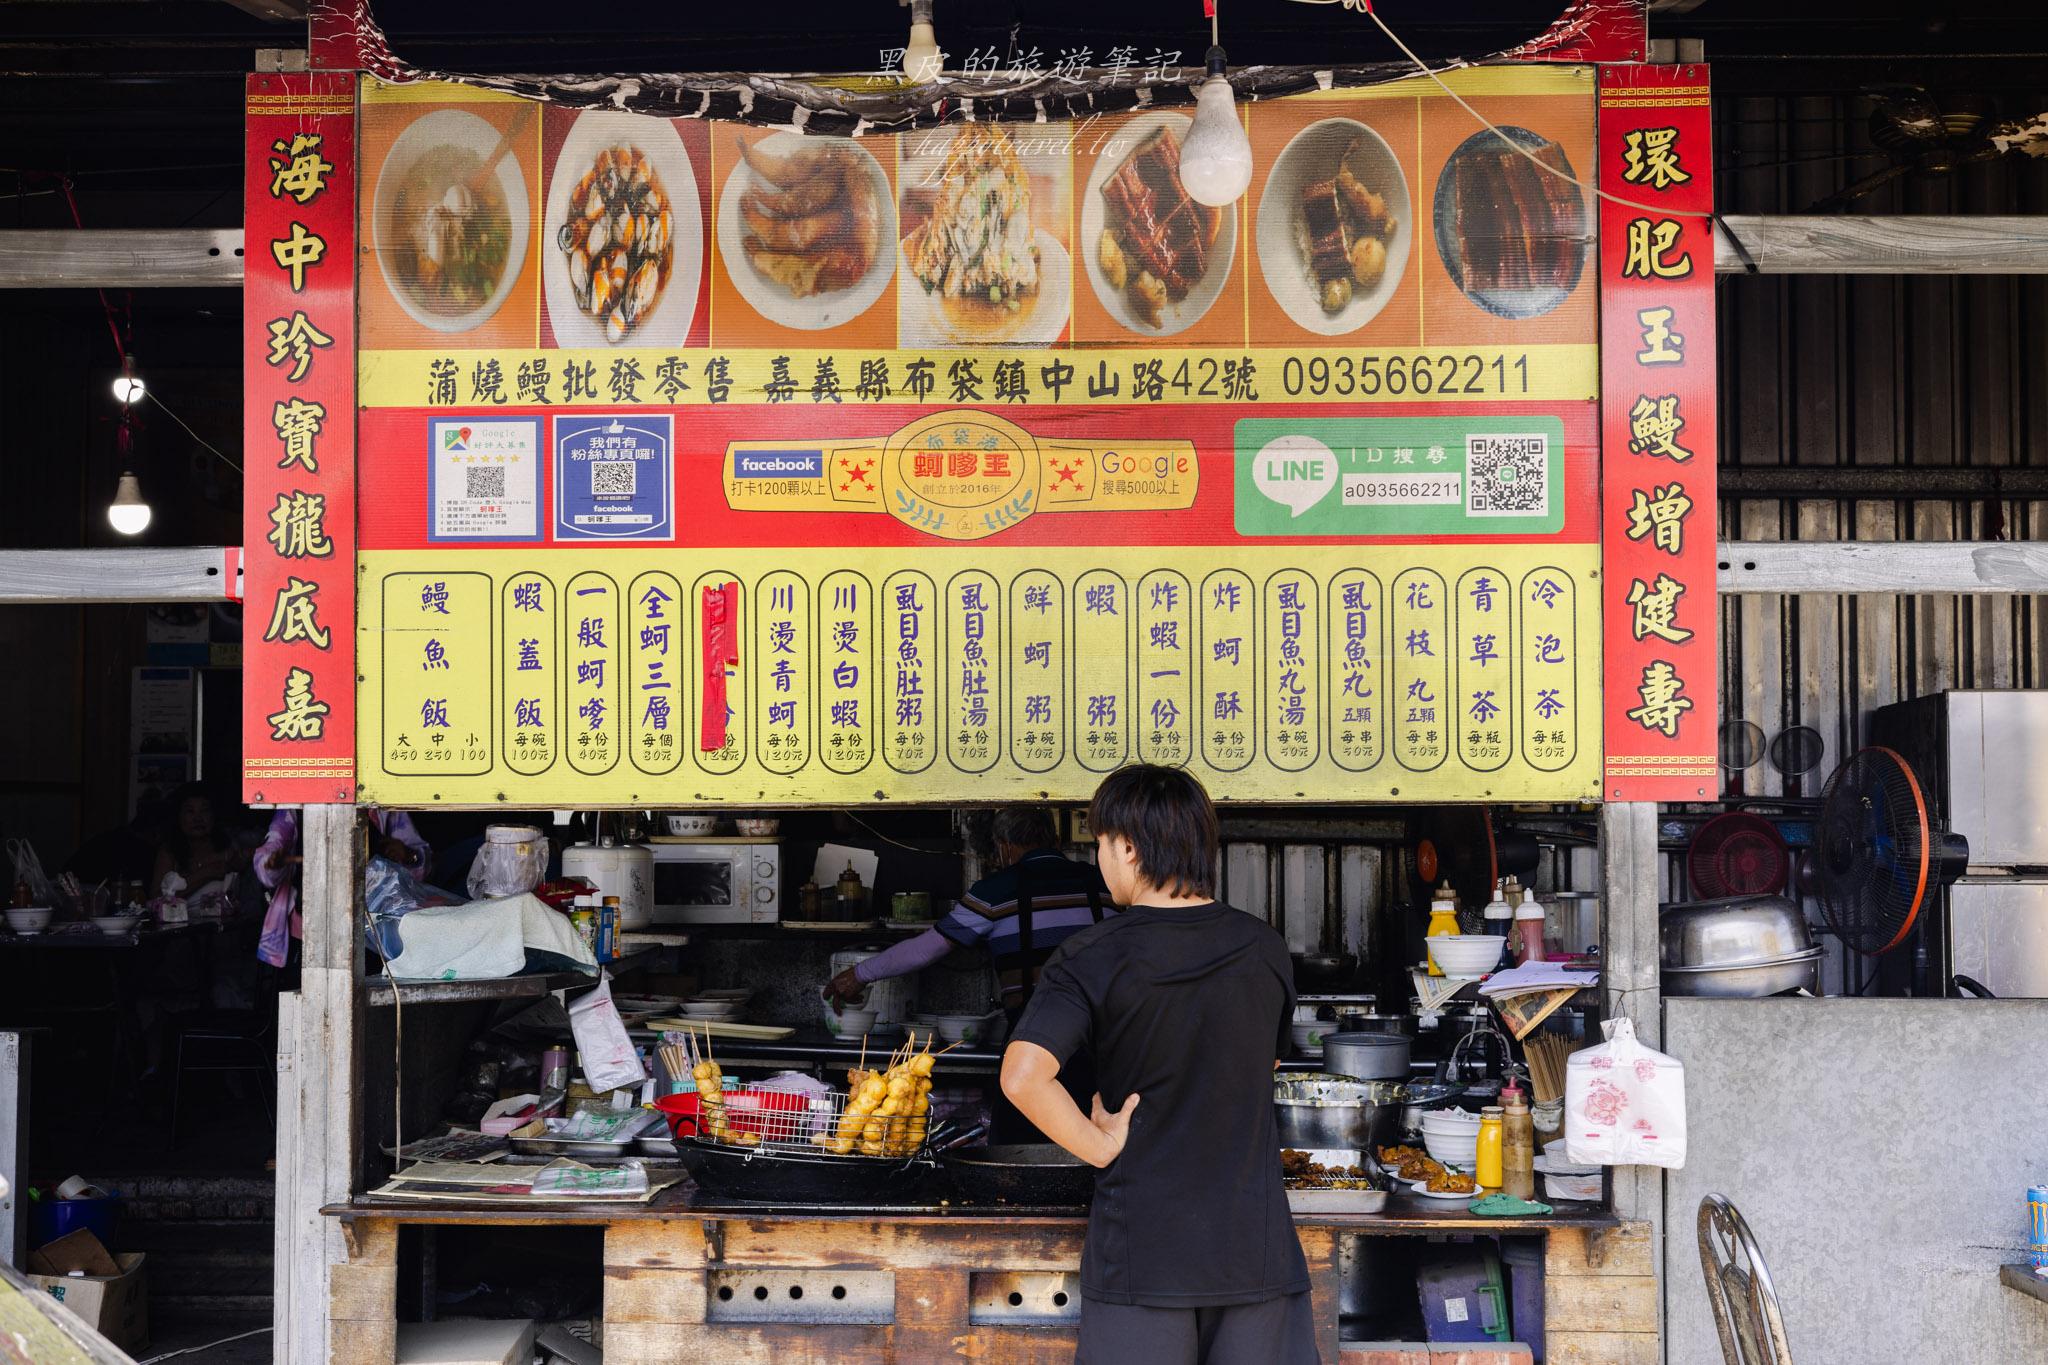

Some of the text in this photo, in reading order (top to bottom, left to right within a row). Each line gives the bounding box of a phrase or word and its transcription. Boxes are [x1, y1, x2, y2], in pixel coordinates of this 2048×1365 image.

[428, 356, 1530, 405] 蒲燒鰻批發零售 嘉義縣布袋鎮中山路42號 0935662211
[266, 133, 333, 740] 海中珍寶攏底嘉
[1622, 127, 1695, 739] 環肥玉鰻增健壽
[590, 437, 637, 449] 我們有
[741, 457, 815, 471] facebook
[913, 451, 1012, 478] 蚵嗲王
[1101, 451, 1189, 478] Google
[1267, 461, 1324, 481] LINE
[731, 480, 826, 496] 打卡1200顆以上
[922, 484, 1002, 495] 創立於2016年
[1102, 480, 1180, 495] 搜尋5000以上
[1345, 483, 1460, 498] a0935662211
[593, 505, 633, 513] facebook
[1342, 581, 1372, 698] 虱目魚丸
[1405, 582, 1435, 703] 花枝丸
[421, 582, 450, 728] 鰻魚飯
[513, 583, 544, 727] 蝦蓋飯
[769, 584, 797, 729] 川燙青蚵
[832, 584, 861, 728] 川燙白蝦
[896, 583, 924, 727] 虱目魚肚粥
[961, 583, 989, 727] 虱目魚肚湯
[1024, 585, 1053, 724] 鮮蚵粥
[1086, 584, 1118, 726] 蝦粥
[1150, 582, 1180, 729] 炸蝦一份
[1213, 582, 1243, 720] 炸蚵酥
[1278, 582, 1306, 726] 虱目魚丸湯
[1469, 577, 1501, 723] 青草茶
[1531, 578, 1566, 720] 冷泡茶
[576, 587, 607, 730] 一般蚵嗲
[640, 586, 673, 730] 全蚵三層
[1342, 707, 1372, 723] 五顆
[1406, 707, 1435, 723] 五顆
[398, 732, 479, 747] 大 中 小
[513, 732, 547, 747] 每碗
[577, 732, 609, 747] 每份
[641, 733, 673, 748] 每個
[766, 732, 801, 748] 每份
[829, 732, 864, 748] 每份
[894, 732, 926, 747] 每份
[957, 731, 990, 746] 每份
[1023, 730, 1056, 746] 每碗
[1086, 730, 1119, 746] 每碗
[1149, 730, 1182, 746] 每份
[1212, 730, 1246, 746] 每份
[1276, 730, 1309, 745] 每碗
[1340, 729, 1373, 745] 每串
[1405, 729, 1438, 745] 每串
[1467, 730, 1502, 745] 每瓶
[1531, 730, 1567, 745] 每瓶
[460, 749, 486, 761] 100
